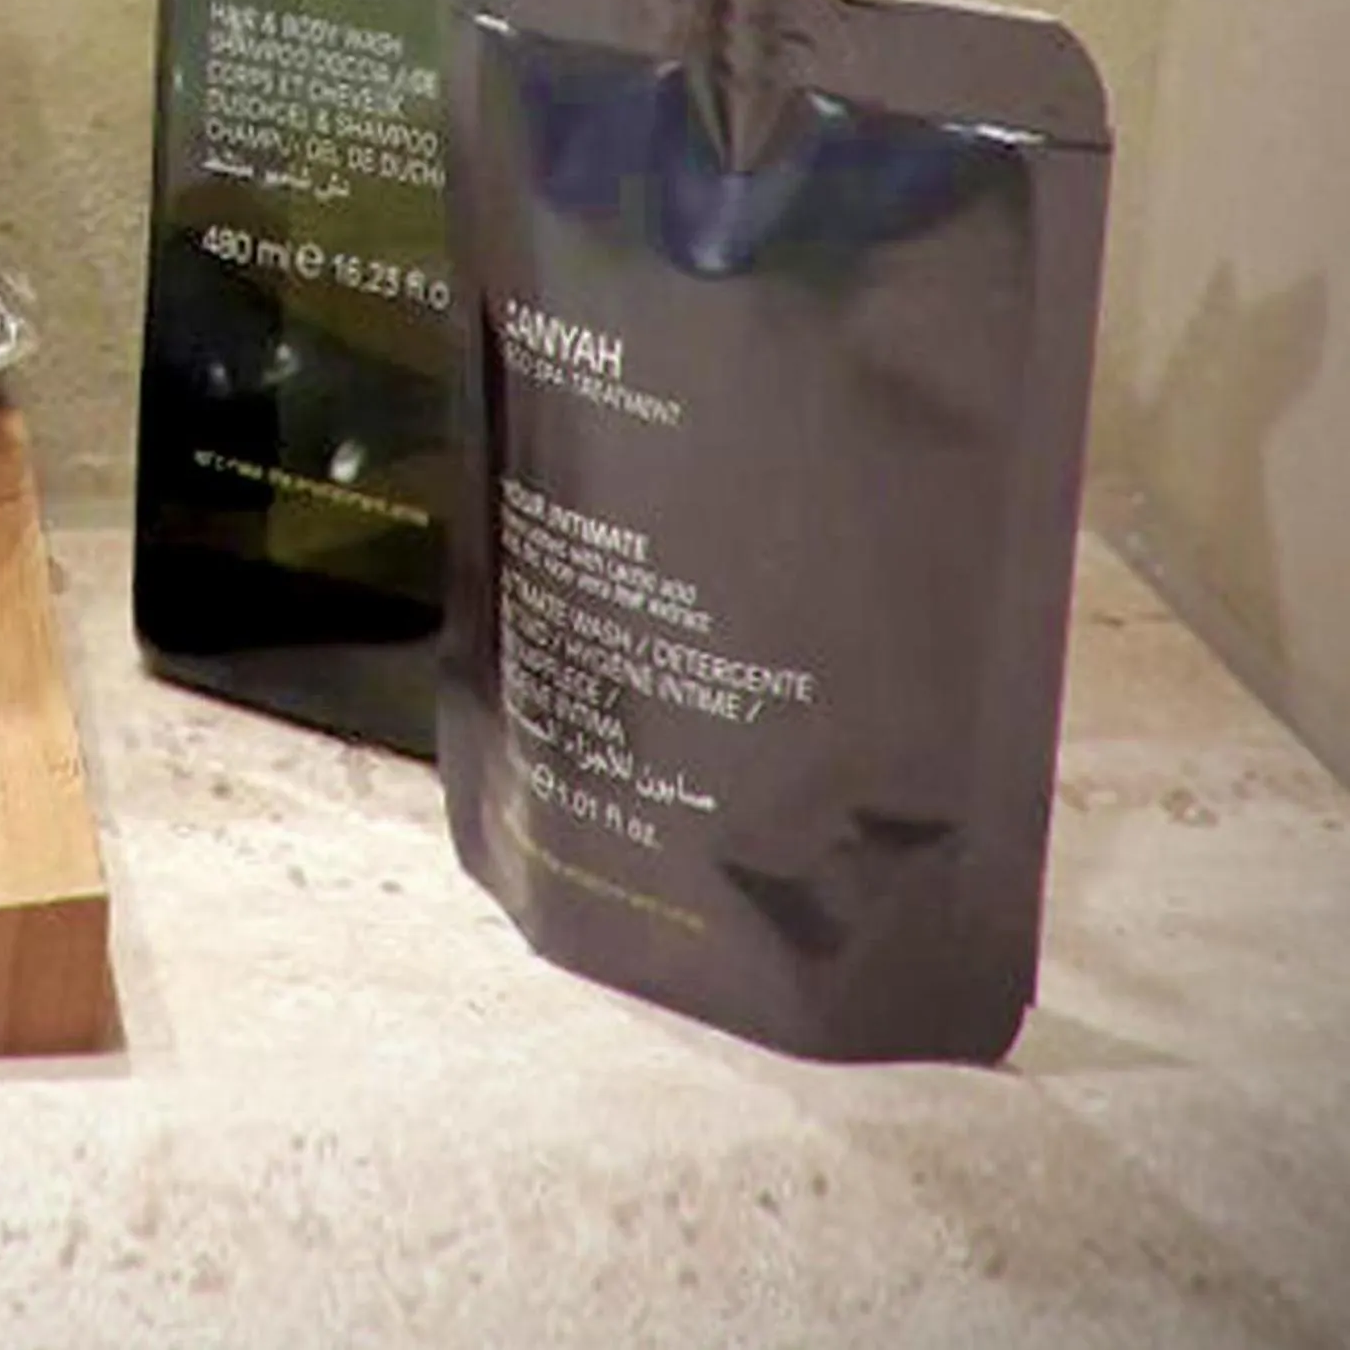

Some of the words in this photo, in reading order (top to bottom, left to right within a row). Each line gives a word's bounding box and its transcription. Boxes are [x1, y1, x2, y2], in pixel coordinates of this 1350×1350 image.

[202, 223, 253, 266] 480
[546, 502, 651, 563] INTIMATE
[652, 635, 818, 706] DETERGENTE
